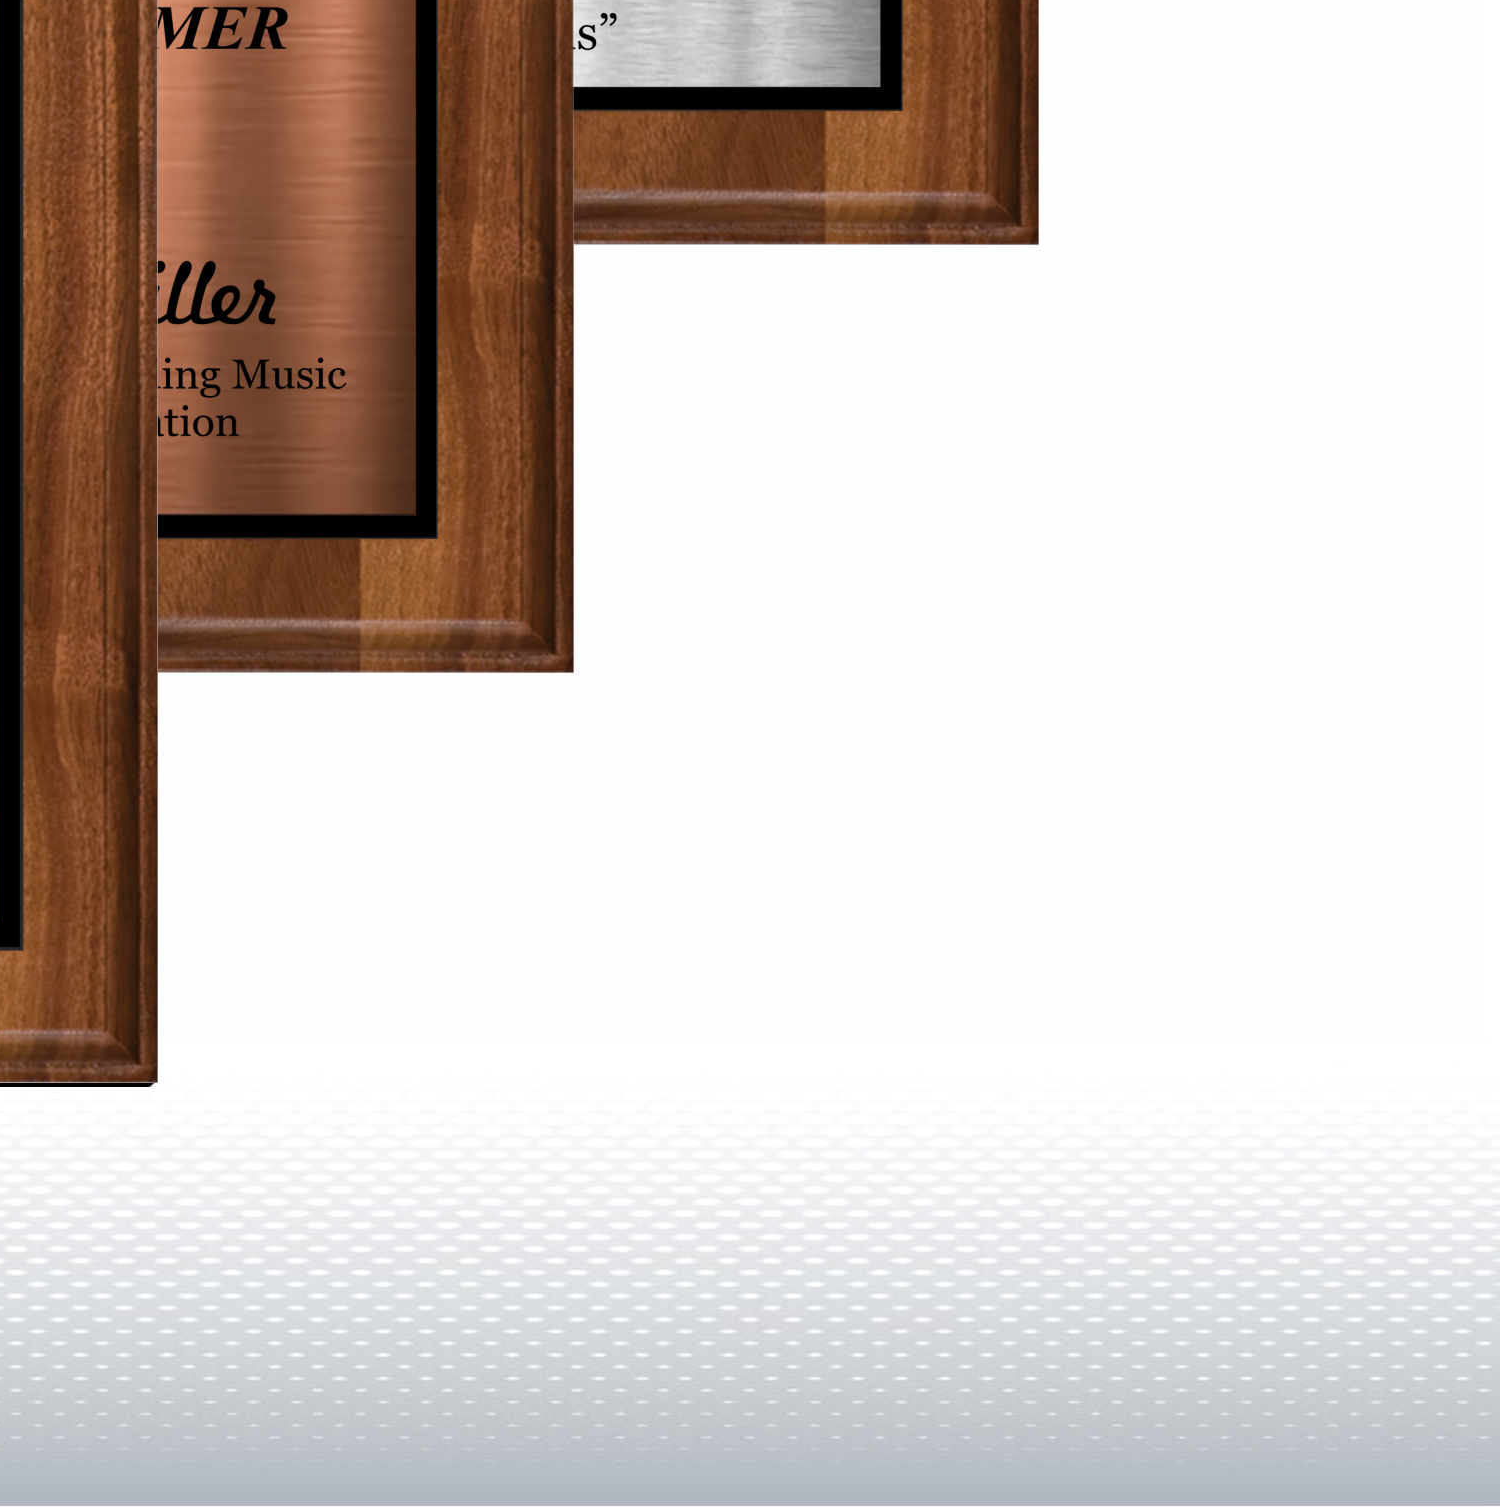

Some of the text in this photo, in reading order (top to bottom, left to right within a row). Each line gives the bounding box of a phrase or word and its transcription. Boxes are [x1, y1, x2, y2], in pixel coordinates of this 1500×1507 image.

[157, 357, 347, 399] ing Music
[157, 404, 240, 437] tion
